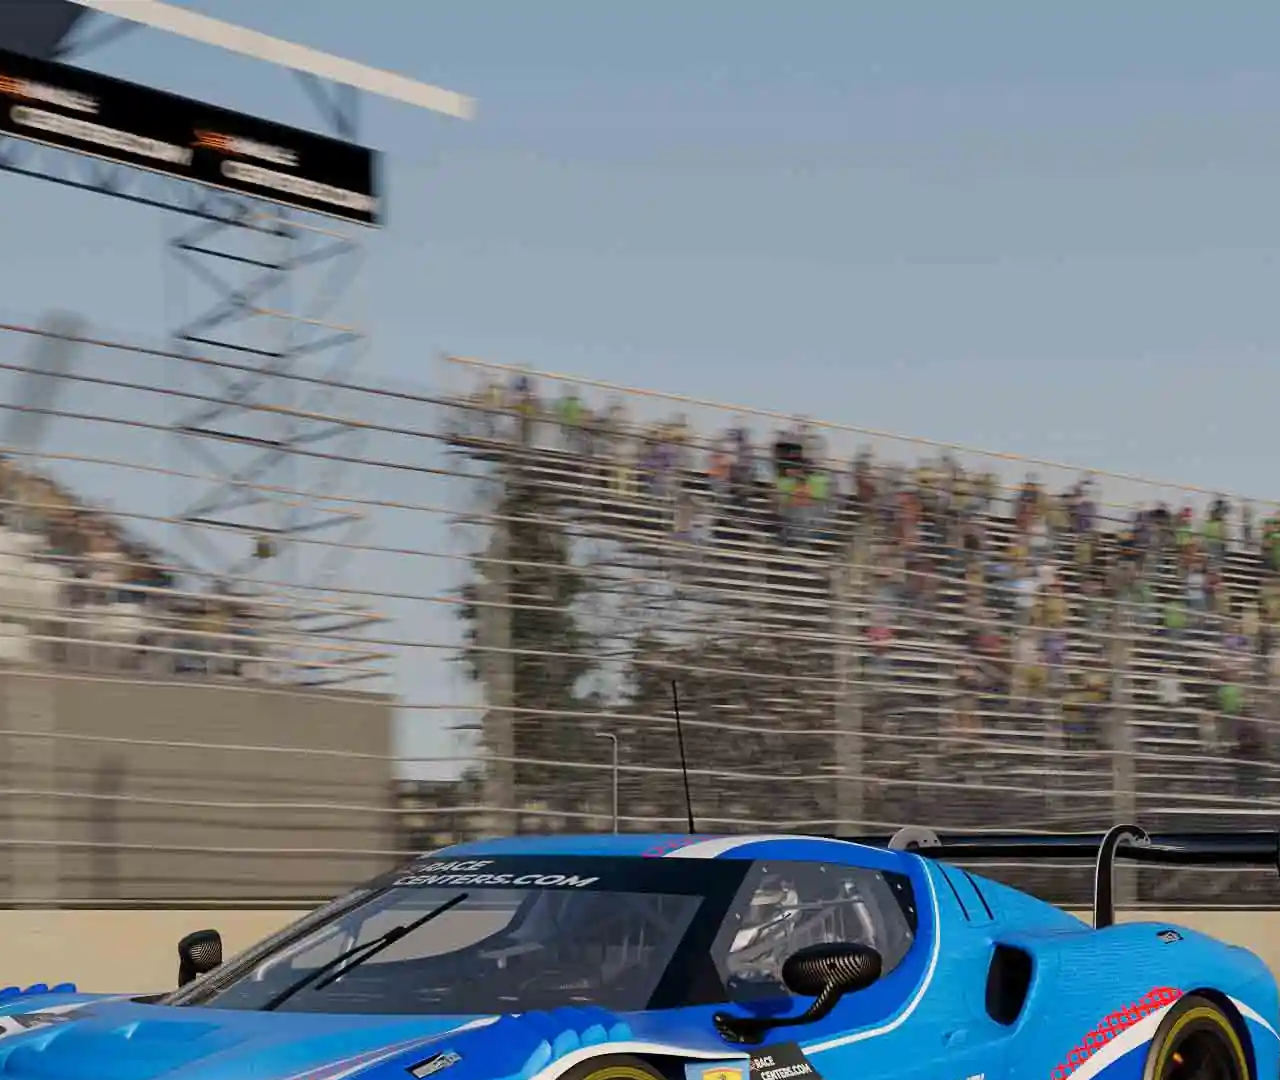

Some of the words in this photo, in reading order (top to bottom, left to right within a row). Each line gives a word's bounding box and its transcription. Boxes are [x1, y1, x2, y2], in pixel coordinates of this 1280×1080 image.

[420, 860, 494, 872] RACE
[393, 874, 600, 887] CENTERS.COM
[753, 1056, 775, 1069] RACE
